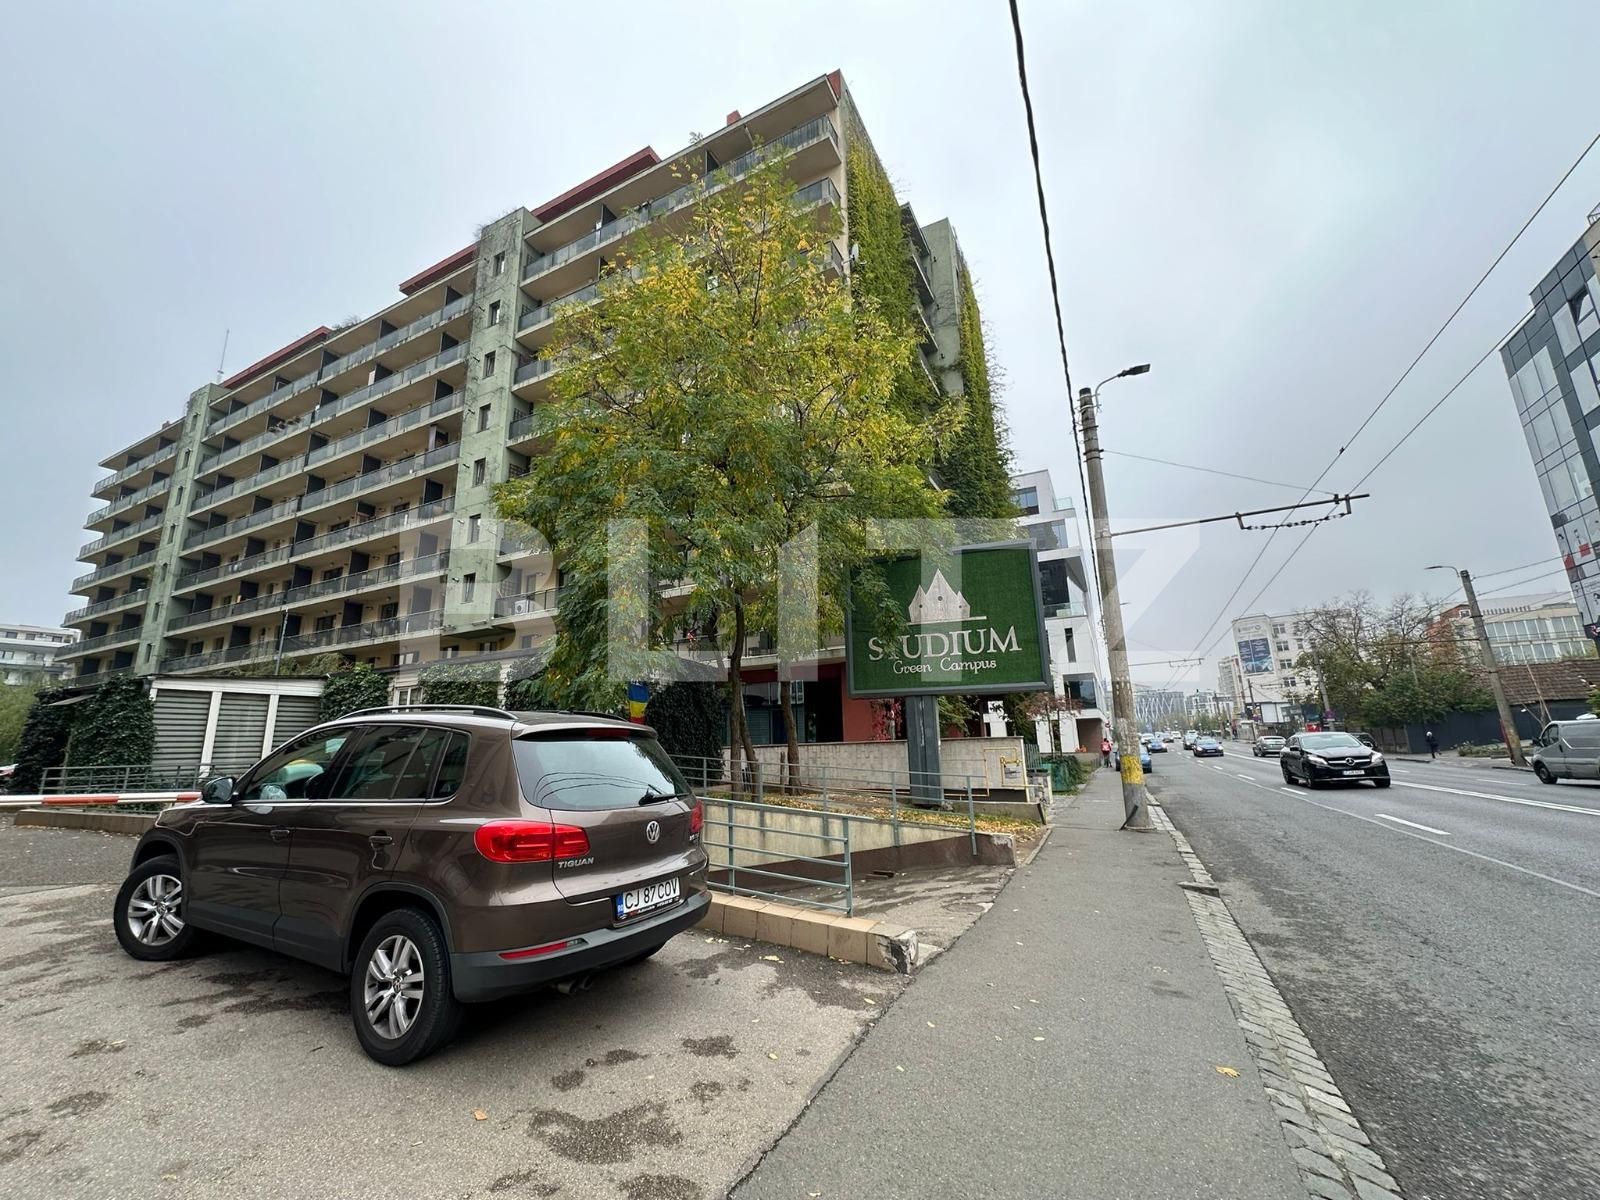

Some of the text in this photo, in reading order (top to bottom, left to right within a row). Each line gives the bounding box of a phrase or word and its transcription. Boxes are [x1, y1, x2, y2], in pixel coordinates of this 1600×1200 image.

[893, 657, 997, 674] Green Campus
[558, 857, 594, 868] TIGUAN
[625, 890, 640, 909] CJ
[643, 886, 656, 904] 87
[657, 877, 678, 899] COV
